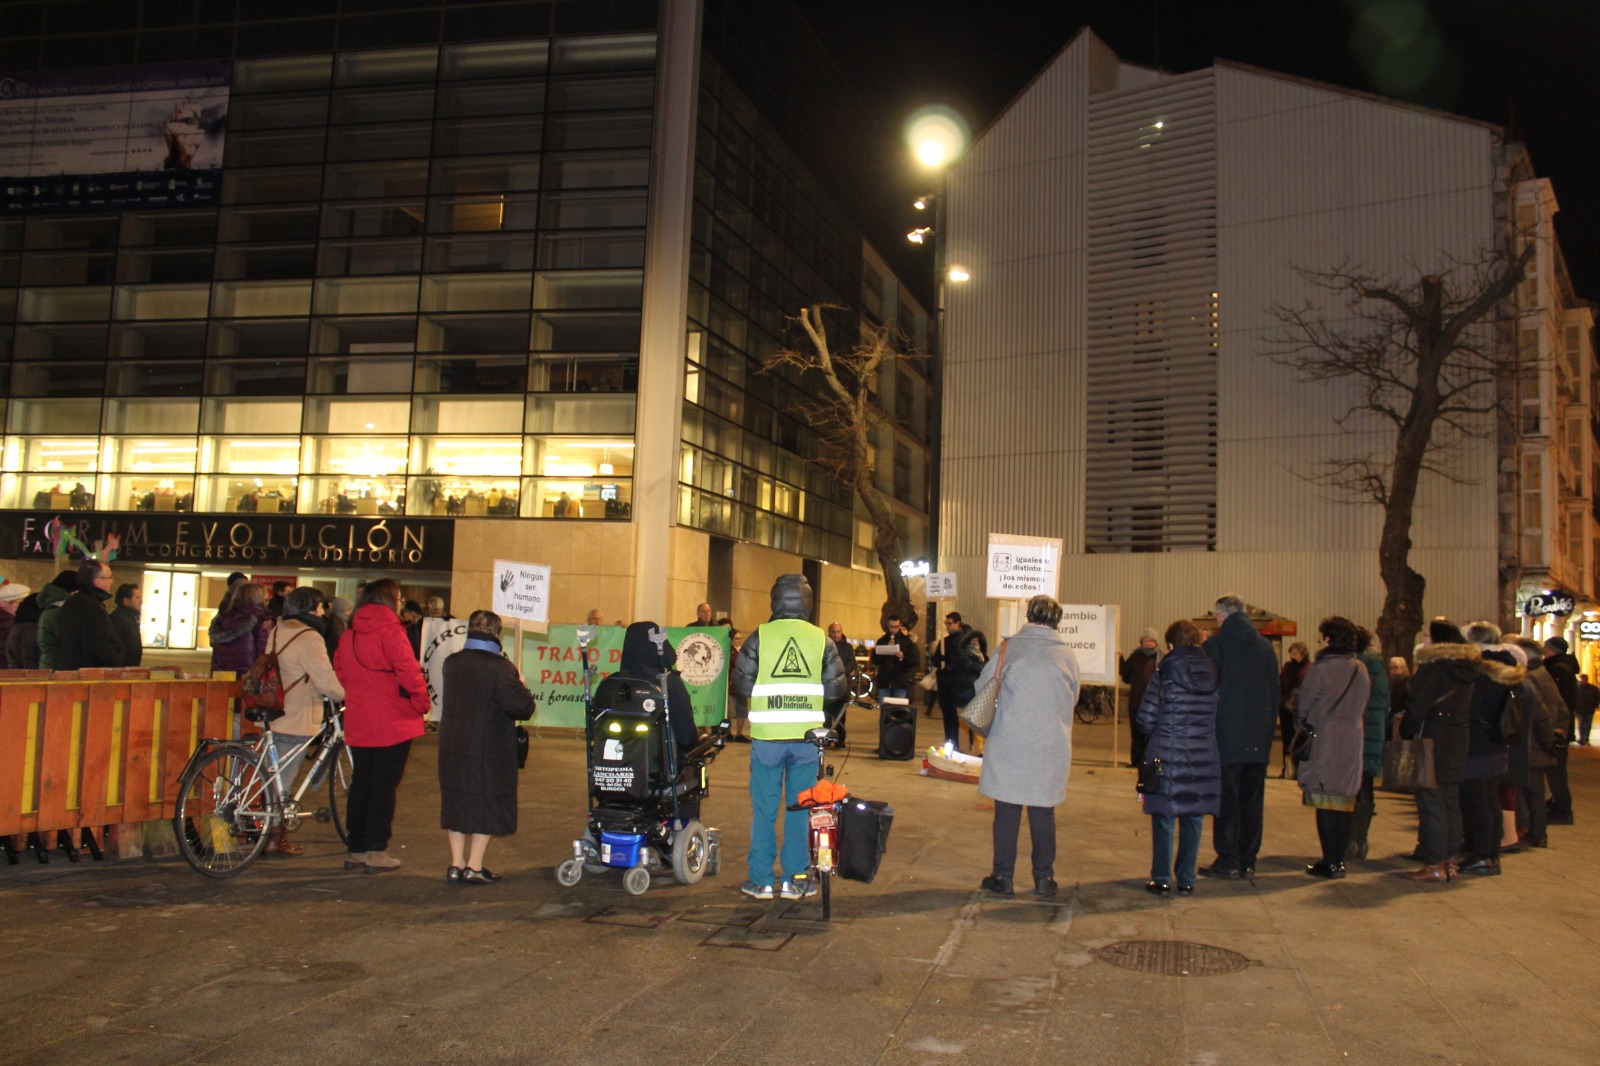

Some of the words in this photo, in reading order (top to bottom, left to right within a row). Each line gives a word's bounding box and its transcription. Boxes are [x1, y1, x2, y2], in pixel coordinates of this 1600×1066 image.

[176, 519, 426, 550] EVOLUCIÓN
[145, 544, 267, 559] CONGRESOS
[282, 547, 290, 560] Y
[303, 547, 422, 563] AUDITORIO
[1016, 556, 1043, 564] iguales
[519, 570, 544, 582] Ningún
[514, 592, 541, 603] humano
[515, 603, 534, 614] ilegal
[537, 646, 600, 662] TRATO
[767, 695, 783, 709] NO
[783, 695, 808, 703] fractura
